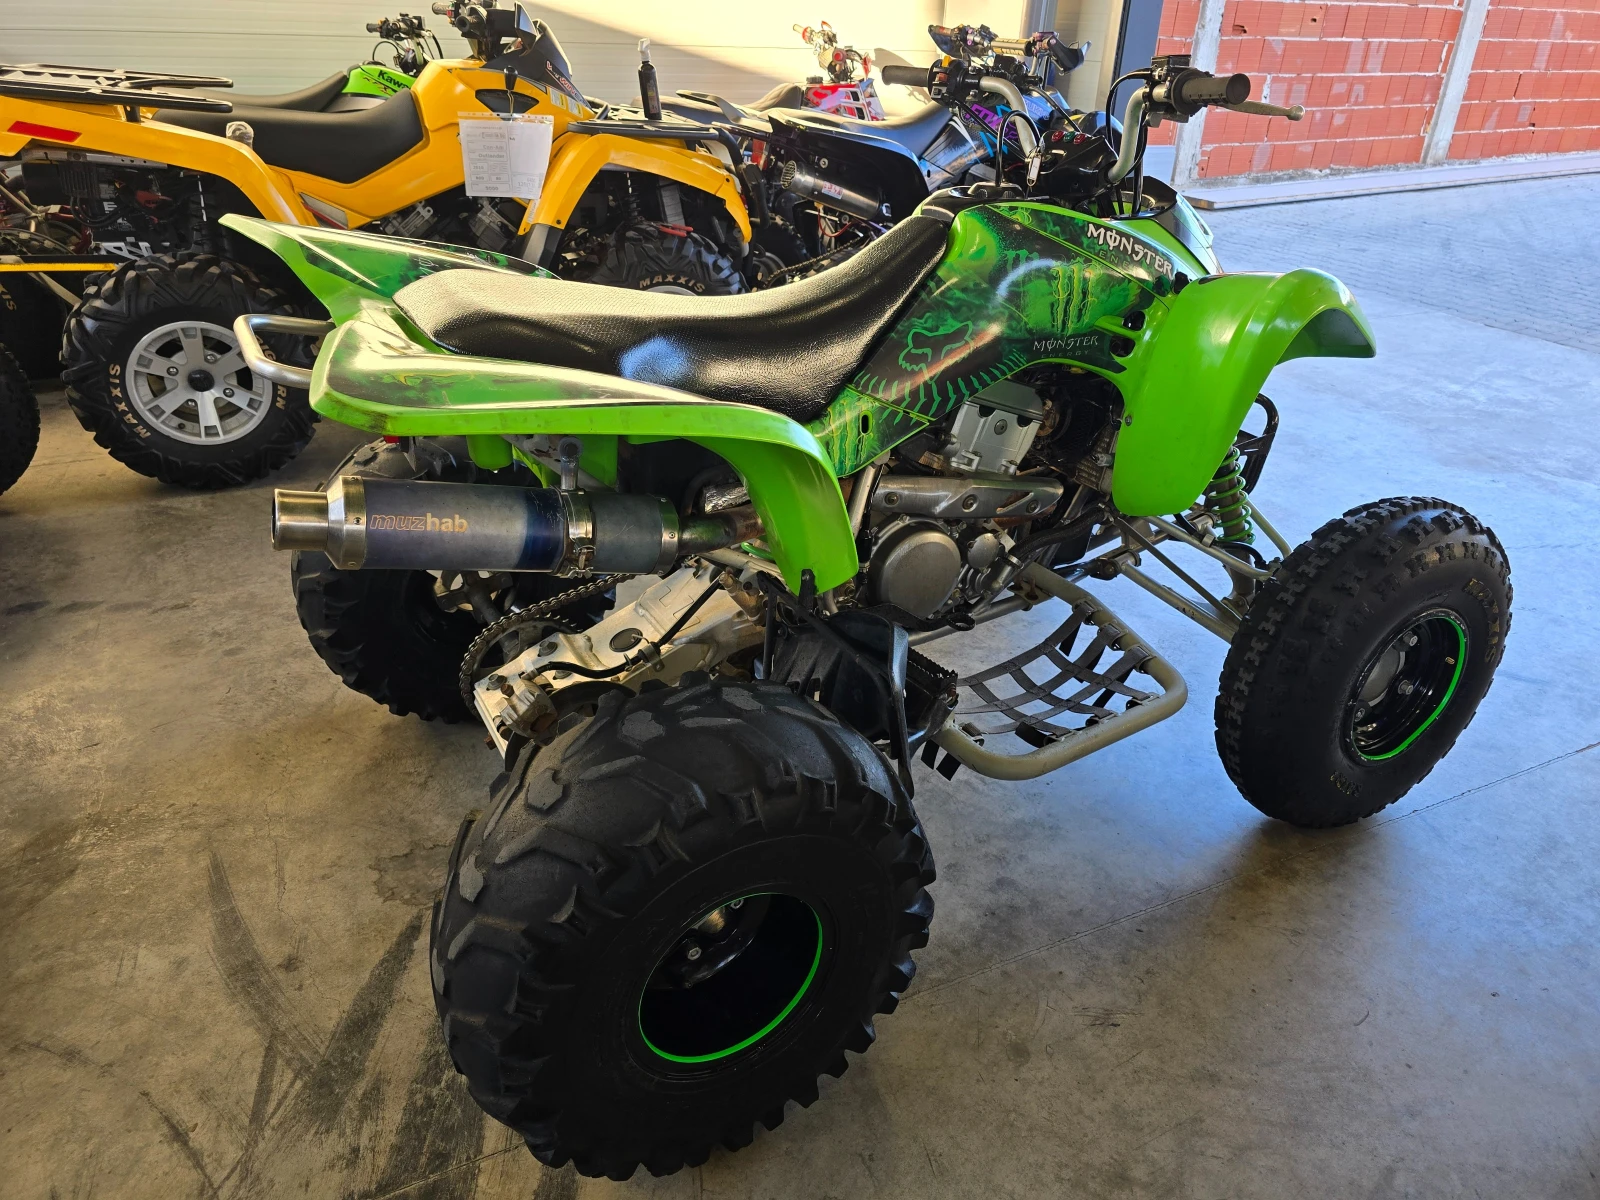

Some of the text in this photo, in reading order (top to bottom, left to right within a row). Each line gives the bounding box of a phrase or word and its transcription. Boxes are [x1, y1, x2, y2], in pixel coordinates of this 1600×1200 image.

[1087, 223, 1174, 280] MONSTER
[640, 273, 705, 293] MAXXIS
[1033, 336, 1099, 352] MONSTER
[109, 363, 152, 439] MAXXIS
[369, 512, 469, 533] muzhab
